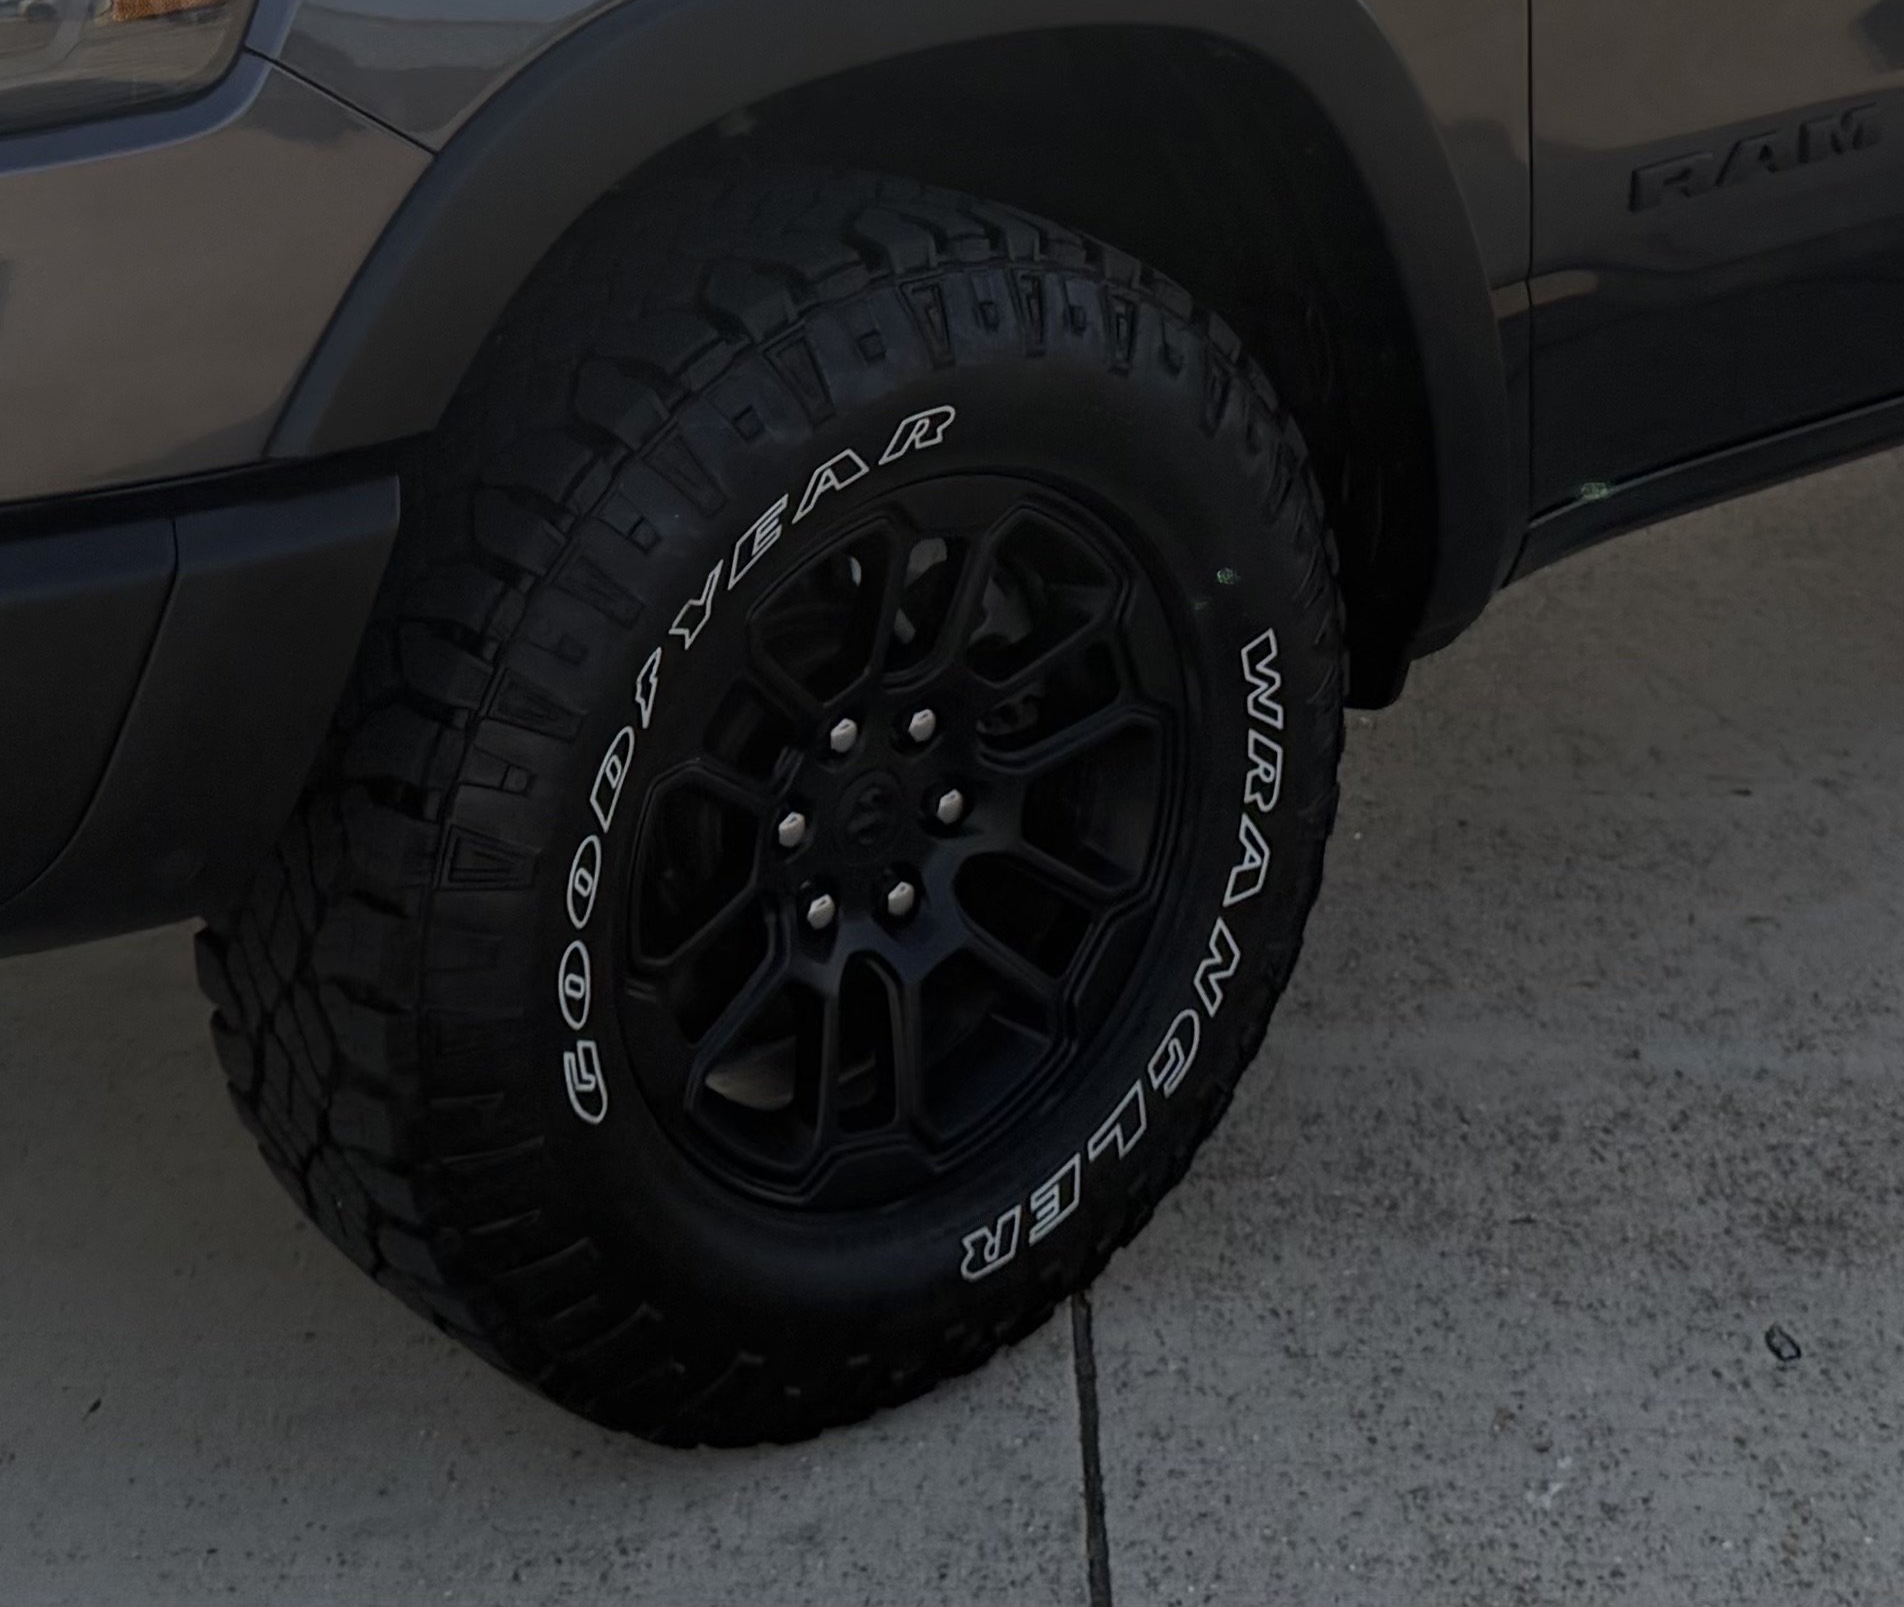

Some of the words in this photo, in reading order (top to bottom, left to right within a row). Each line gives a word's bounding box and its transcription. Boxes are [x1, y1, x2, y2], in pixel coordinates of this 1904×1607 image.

[1628, 101, 1882, 213] RAM
[558, 405, 955, 1124] GOODYEAR
[960, 629, 1283, 1280] WRANGLER
